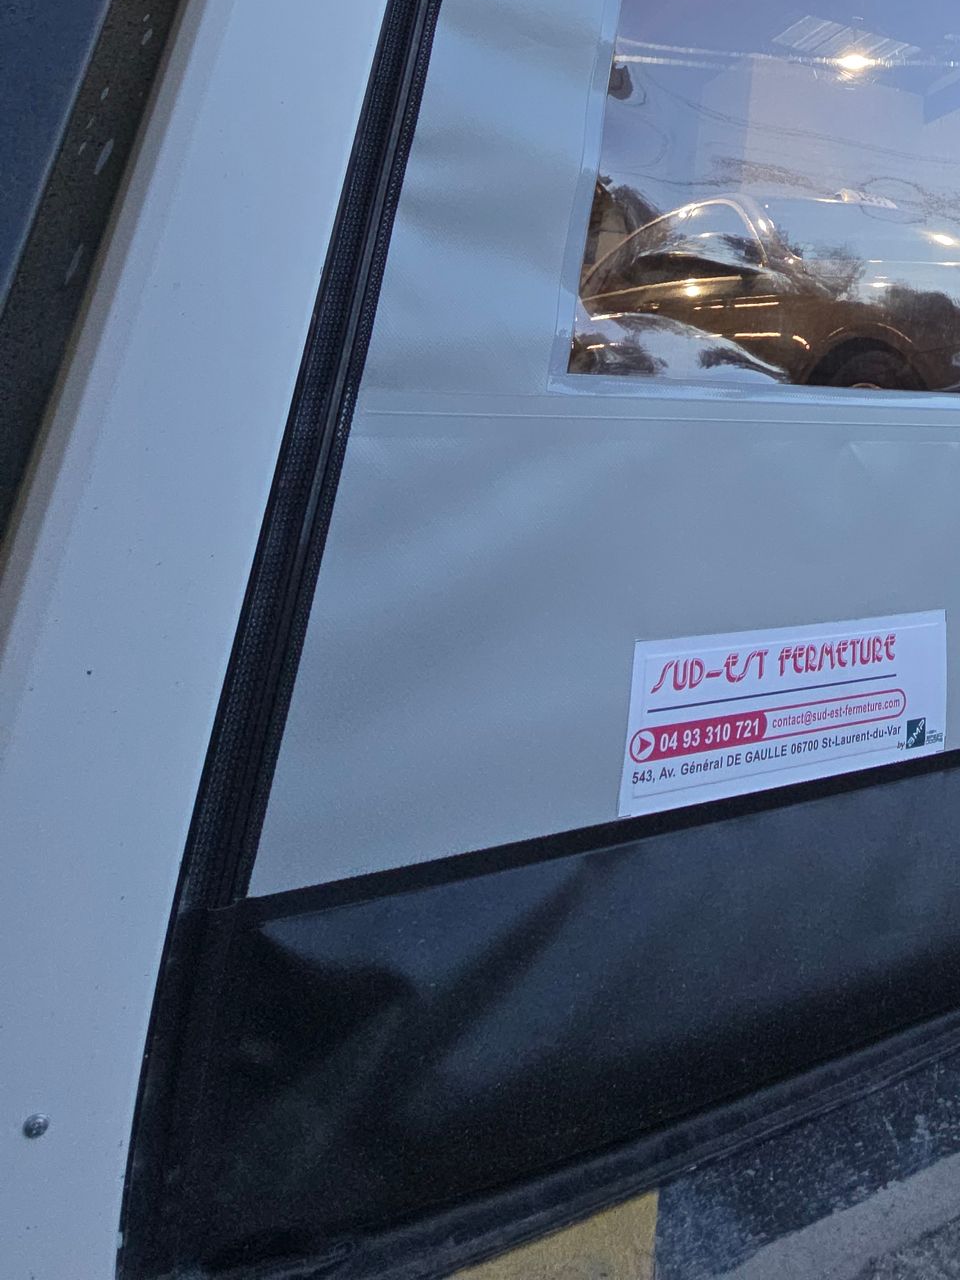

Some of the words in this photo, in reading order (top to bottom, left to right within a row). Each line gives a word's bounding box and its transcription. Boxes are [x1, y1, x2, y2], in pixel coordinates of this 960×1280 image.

[650, 649, 769, 694] SUD-EST
[778, 633, 896, 676] FERMETURE
[772, 698, 900, 728] contact@sud-est-fermeture.com
[659, 733, 678, 752] 04
[683, 728, 700, 748] 93
[705, 723, 731, 744] 310
[736, 718, 760, 739] 721
[896, 739, 906, 750] by
[632, 770, 655, 784] 543,
[659, 767, 675, 780] Av.
[681, 757, 723, 775] Général
[726, 753, 741, 767] DE
[745, 744, 788, 763] GAULLE
[791, 740, 819, 754] 06700
[822, 725, 901, 748] St-Laurent-du-Var
